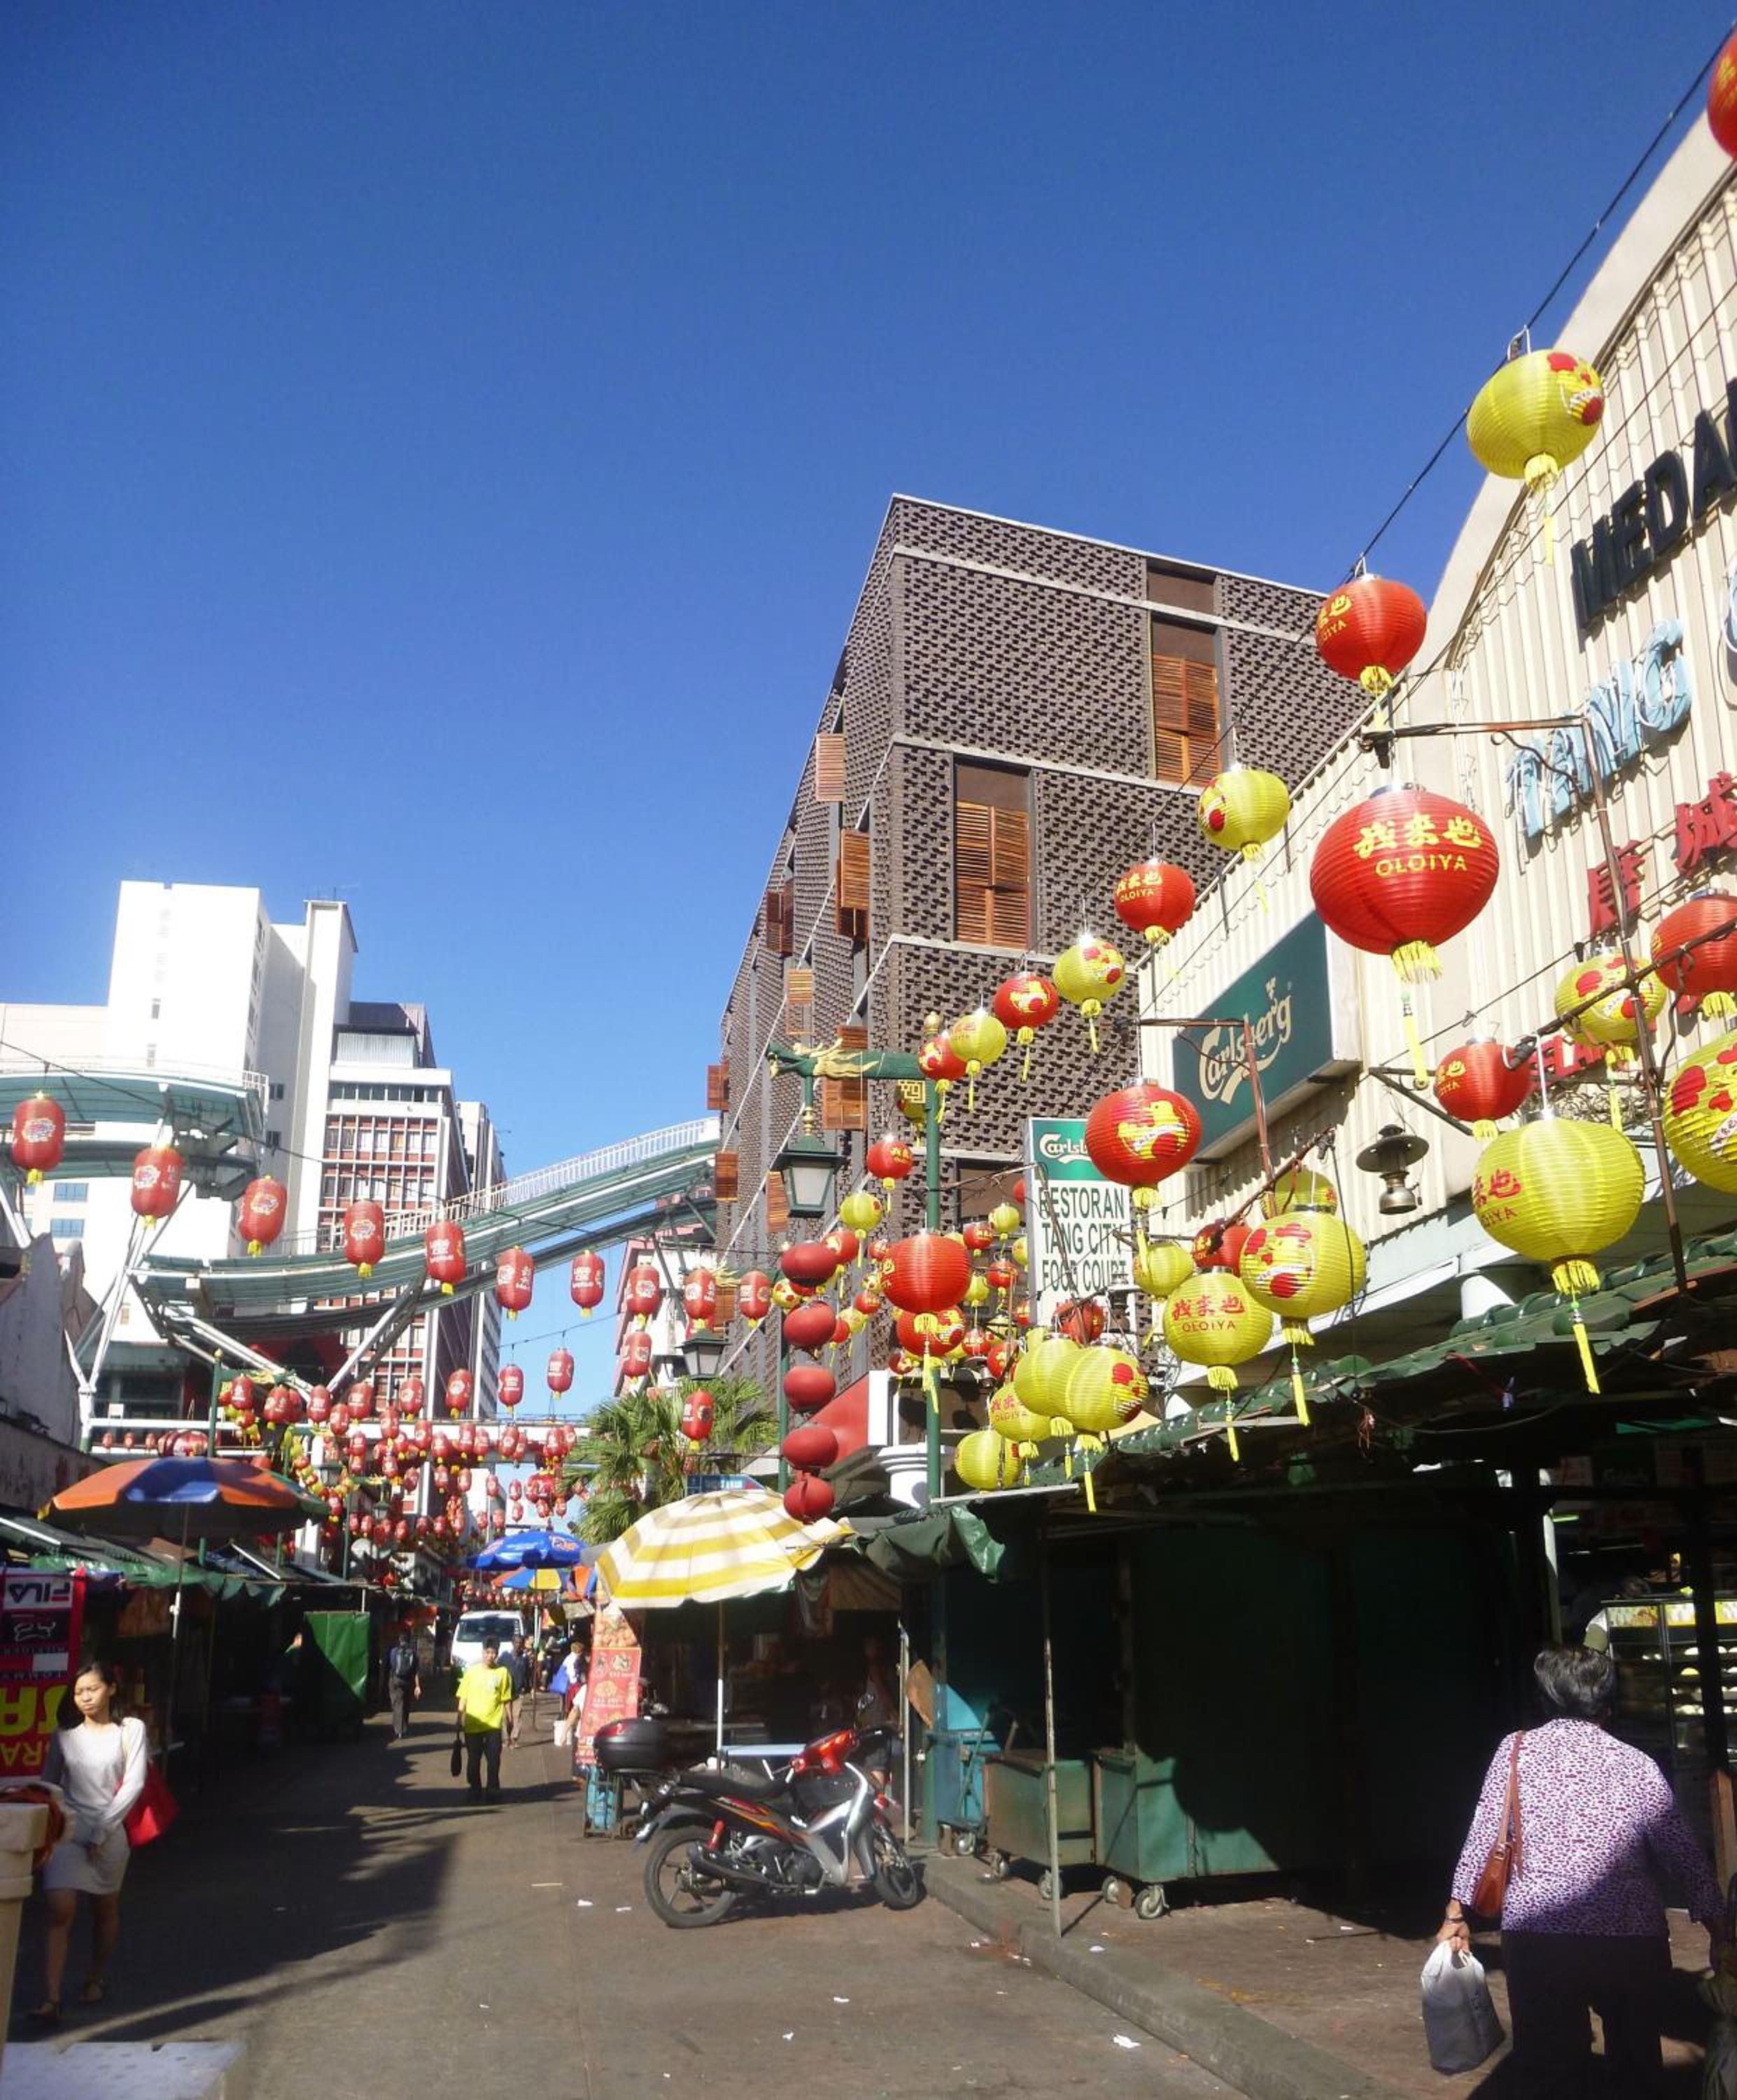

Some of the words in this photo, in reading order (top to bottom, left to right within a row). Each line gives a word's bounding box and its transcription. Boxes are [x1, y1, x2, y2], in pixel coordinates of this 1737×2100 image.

[1570, 377, 1737, 631] MEDA
[1375, 854, 1468, 877] OLOIYA
[1040, 1133, 1089, 1159] Carlsb
[1039, 1186, 1125, 1219] RESTORAN
[1041, 1223, 1084, 1254] TANG
[1182, 1320, 1237, 1333] OLOIYA
[8, 1582, 70, 1603] FILA
